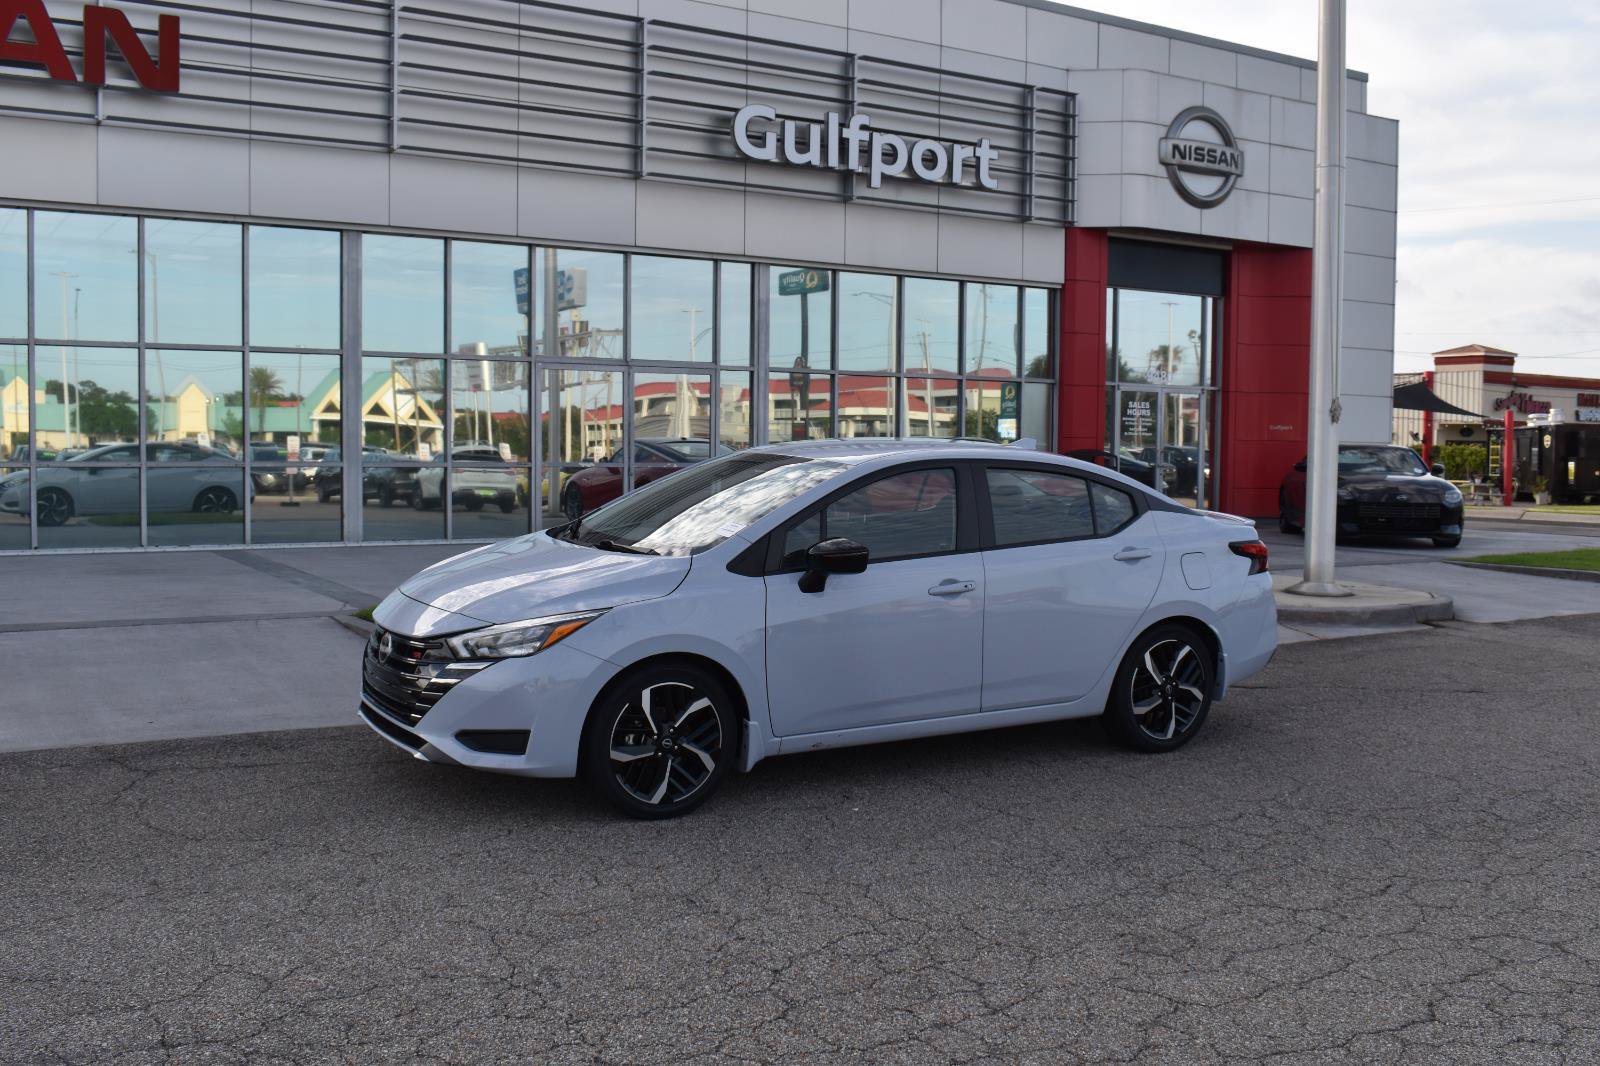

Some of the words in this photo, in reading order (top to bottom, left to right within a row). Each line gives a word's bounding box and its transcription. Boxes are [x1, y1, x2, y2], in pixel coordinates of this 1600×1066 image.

[0, 0, 180, 93] AN
[733, 104, 999, 189] Gulfport
[1172, 143, 1239, 169] NISSAN
[1127, 408, 1151, 416] HOURS
[1128, 401, 1150, 409] SALES
